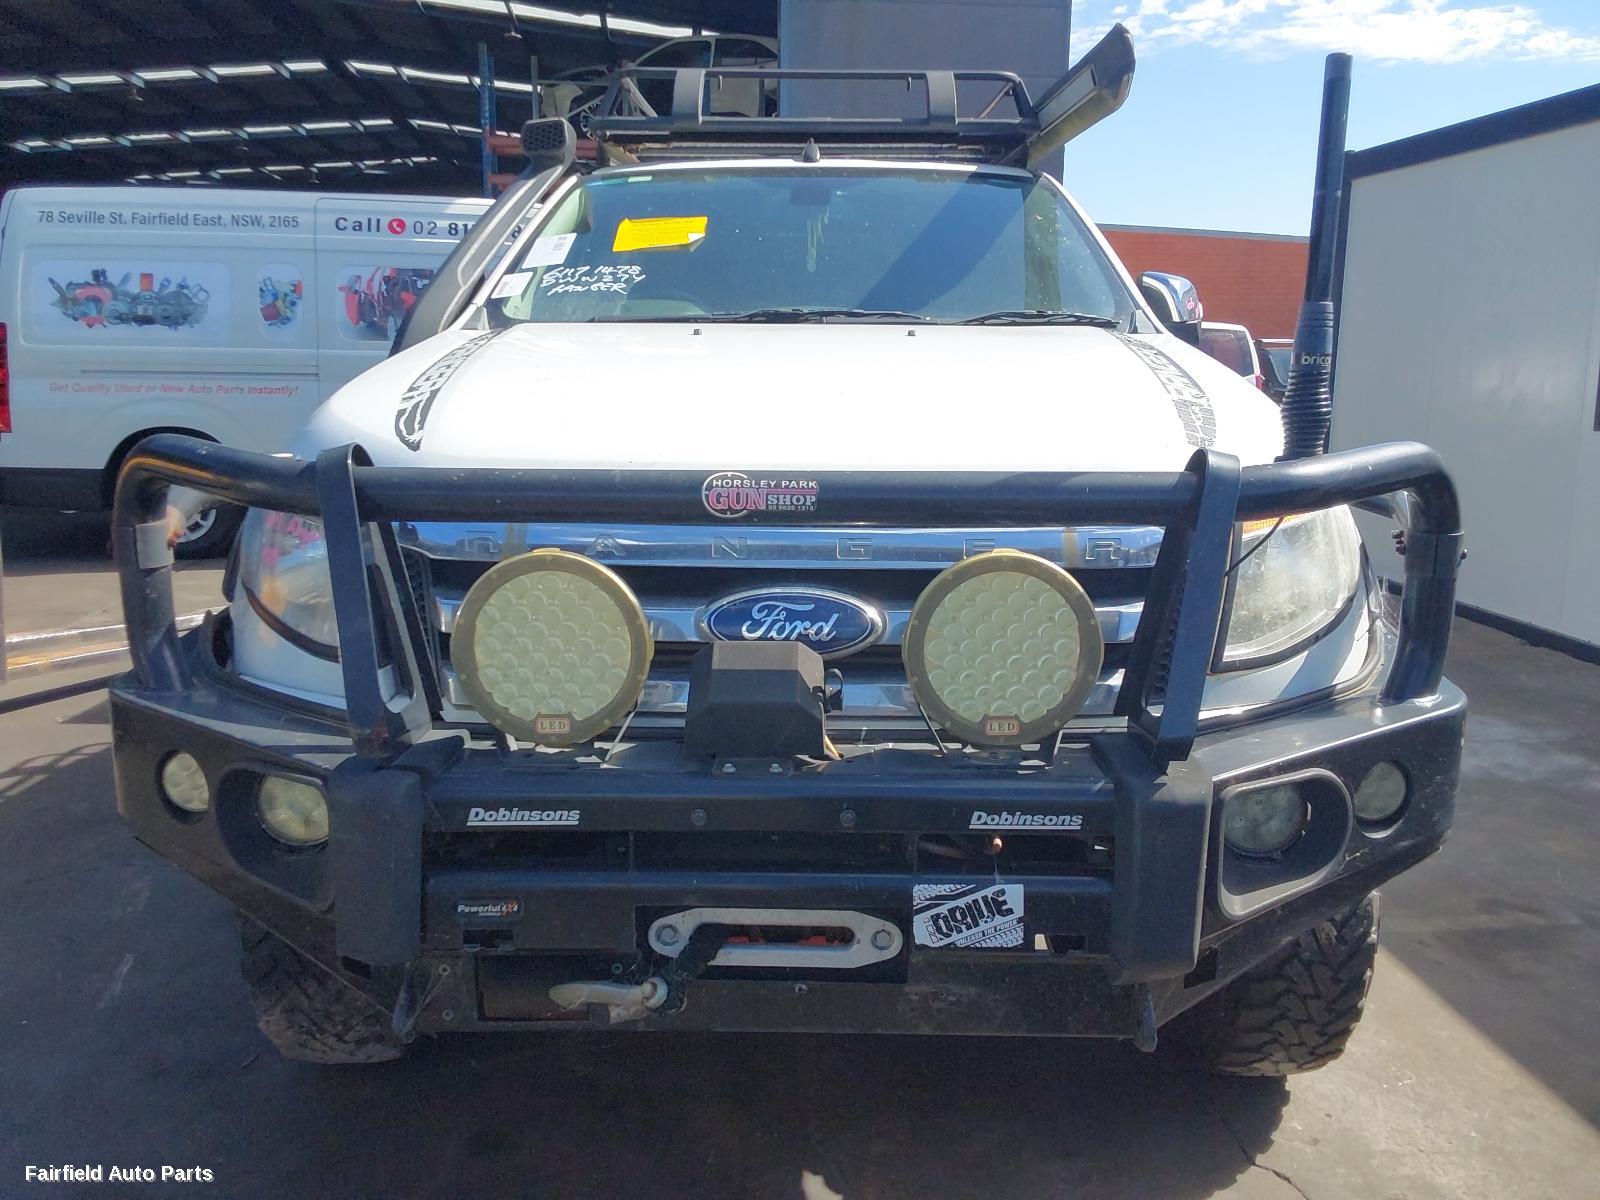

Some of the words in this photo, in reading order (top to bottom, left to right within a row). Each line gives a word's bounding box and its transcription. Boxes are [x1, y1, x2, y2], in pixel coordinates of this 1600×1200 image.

[38, 211, 54, 223] 78
[58, 211, 105, 224] Seville
[109, 212, 127, 225] St.
[131, 212, 189, 226] Fairfield
[231, 214, 265, 228] NSW,
[269, 215, 300, 228] 2165
[335, 217, 381, 232] Call
[413, 221, 438, 236] 02
[50, 382, 69, 392] Get
[72, 382, 110, 395] Quality
[216, 384, 244, 394] Parts
[247, 385, 299, 397] Instantly!
[712, 479, 777, 488] HORSLEY
[781, 480, 817, 489] PARK
[708, 487, 768, 510] GUN
[767, 494, 816, 506] SHOP
[741, 601, 839, 641] Ford
[540, 720, 567, 730] LED
[989, 721, 1016, 732] LED
[468, 807, 581, 821] Dobinsons
[970, 811, 1083, 826] Dobinsons
